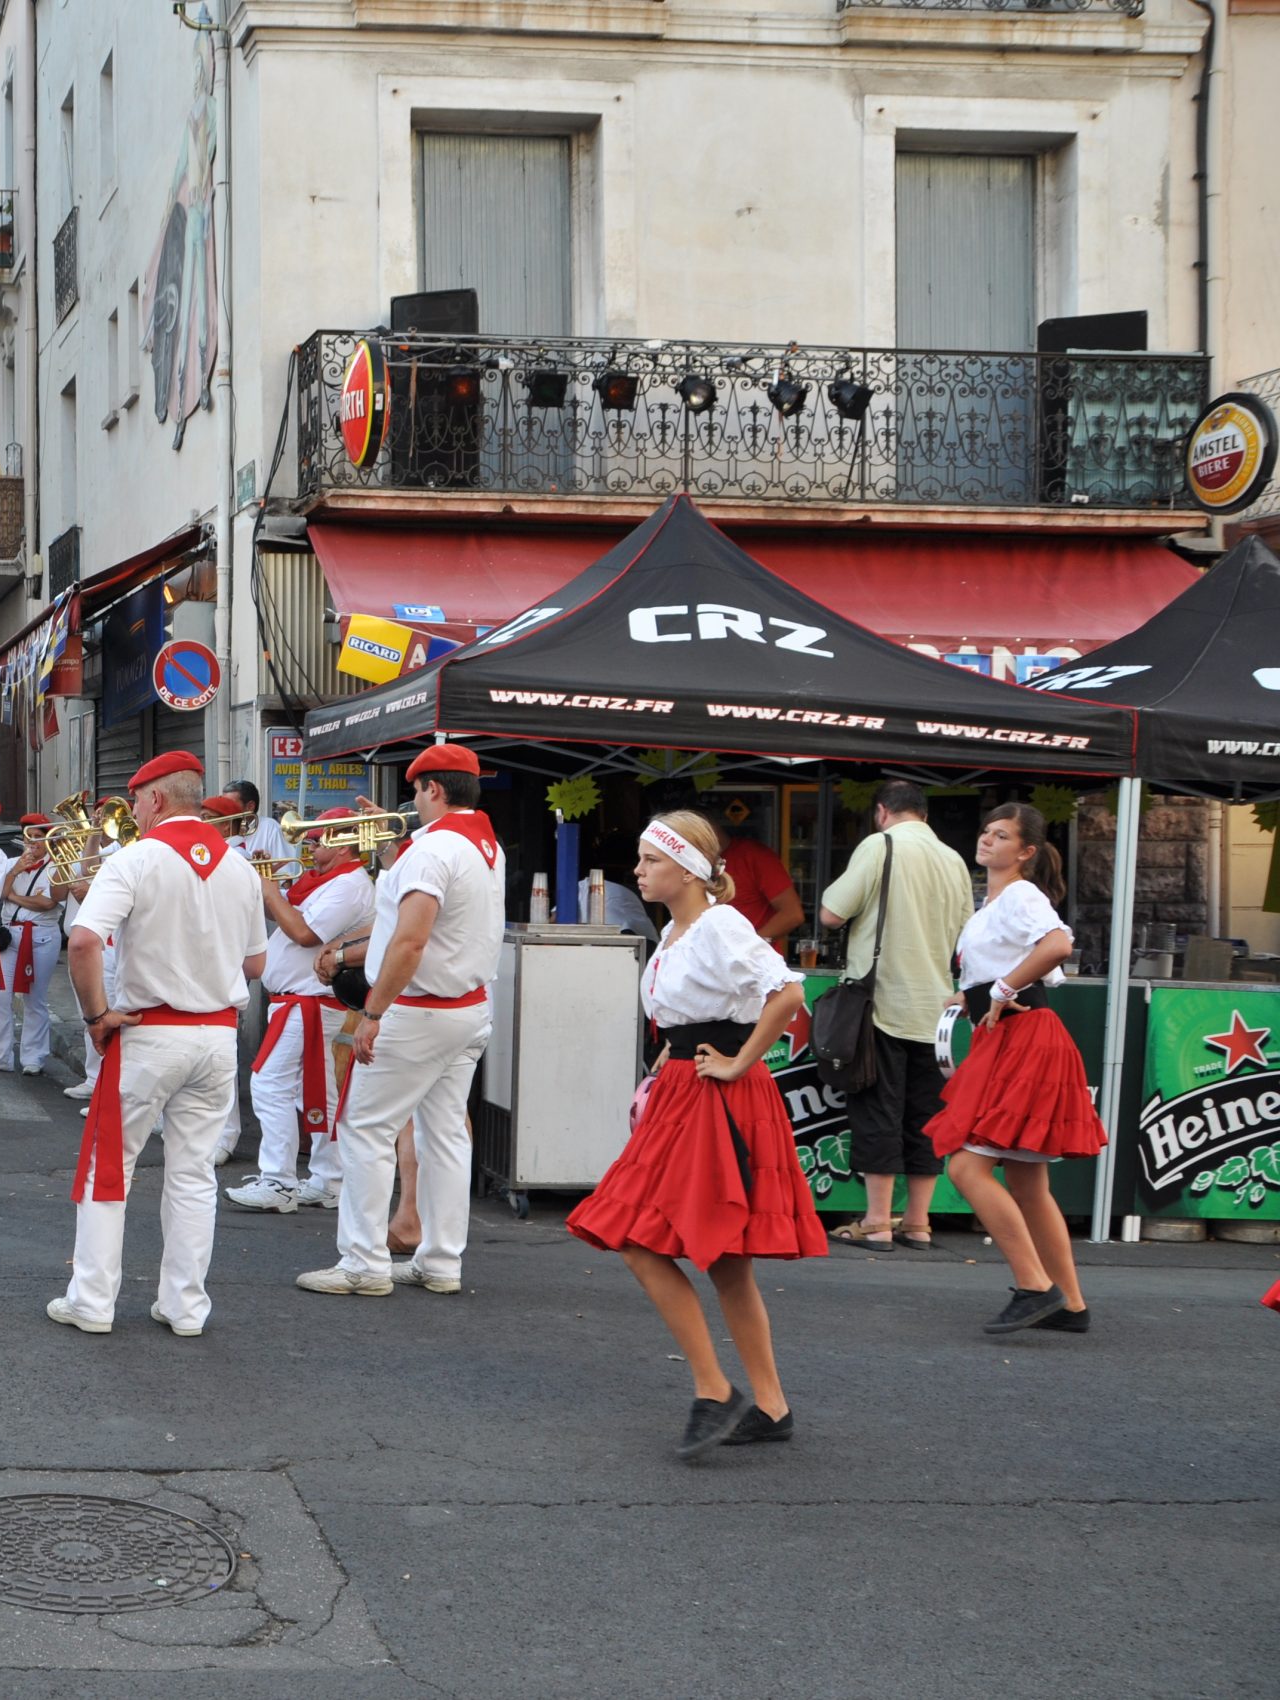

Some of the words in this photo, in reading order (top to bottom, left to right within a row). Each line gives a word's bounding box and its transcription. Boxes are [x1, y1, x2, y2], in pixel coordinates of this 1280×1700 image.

[1193, 434, 1239, 460] AMSTEL
[1198, 457, 1230, 478] BIERE
[628, 604, 834, 658] CRZ
[350, 637, 400, 662] RICARD
[159, 685, 174, 702] DE
[174, 697, 189, 707] CE
[489, 690, 674, 713] WWW.CRZ.FR
[707, 704, 886, 730] WWW.CRZ.FR
[917, 721, 1090, 749] WWW.CRZ.FR
[1193, 1061, 1223, 1074] TRADE
[1146, 1091, 1280, 1169] Heine
